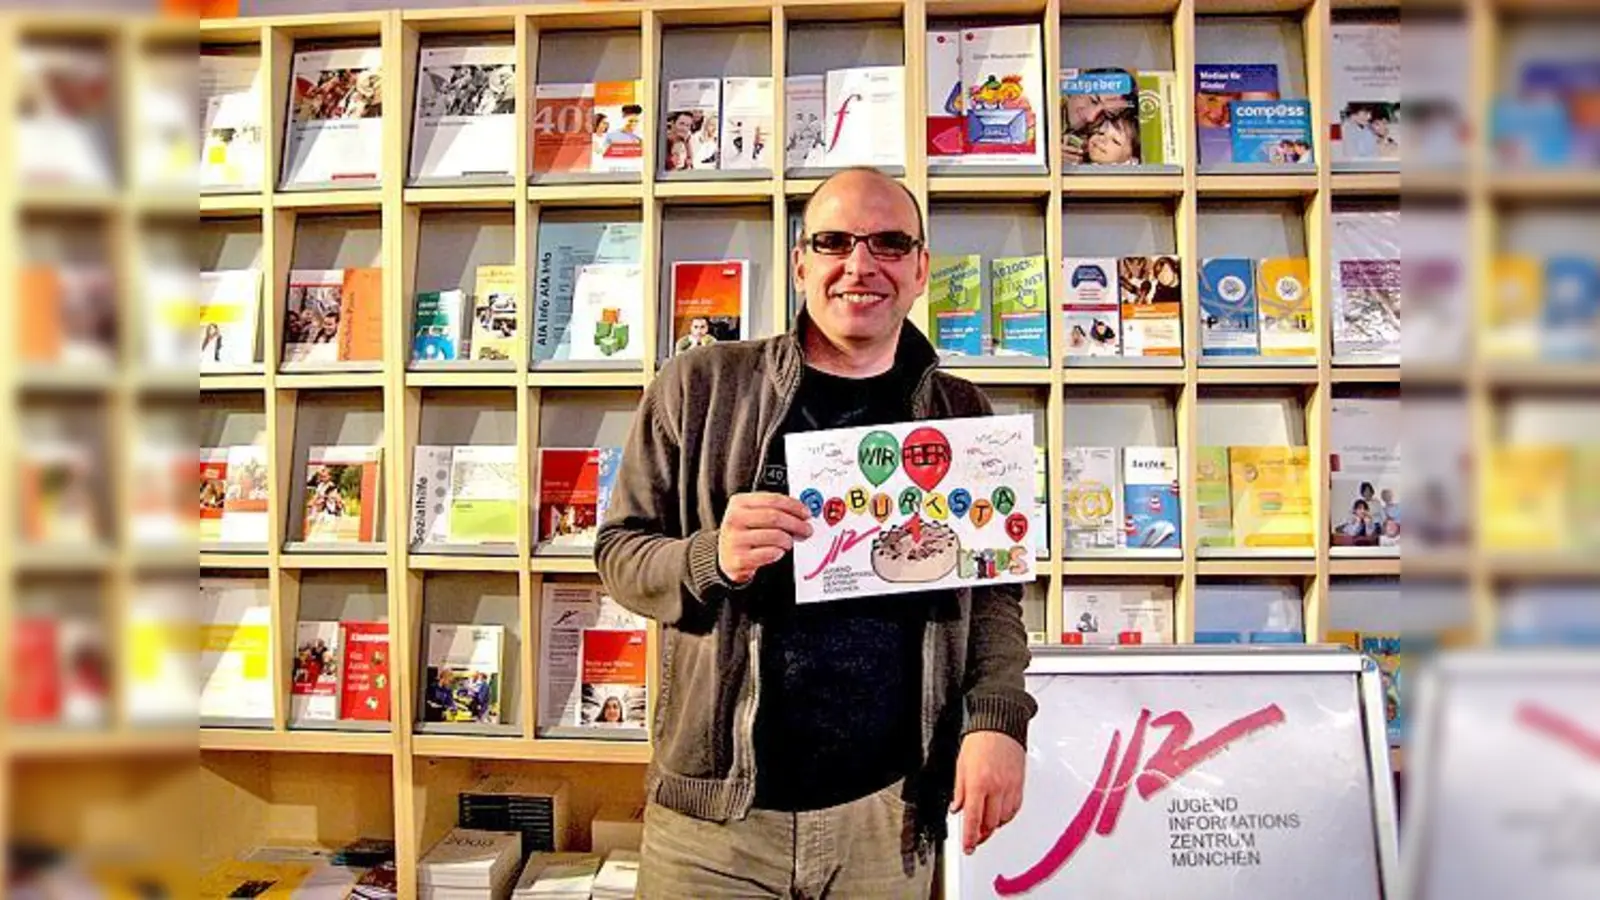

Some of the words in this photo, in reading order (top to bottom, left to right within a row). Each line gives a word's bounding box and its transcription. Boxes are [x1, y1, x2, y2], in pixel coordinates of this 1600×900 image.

[860, 447, 896, 466] WIR
[1167, 797, 1238, 813] JUGEND
[1170, 832, 1255, 849] ZENTRUM
[1172, 850, 1261, 867] MÜNCHEN
